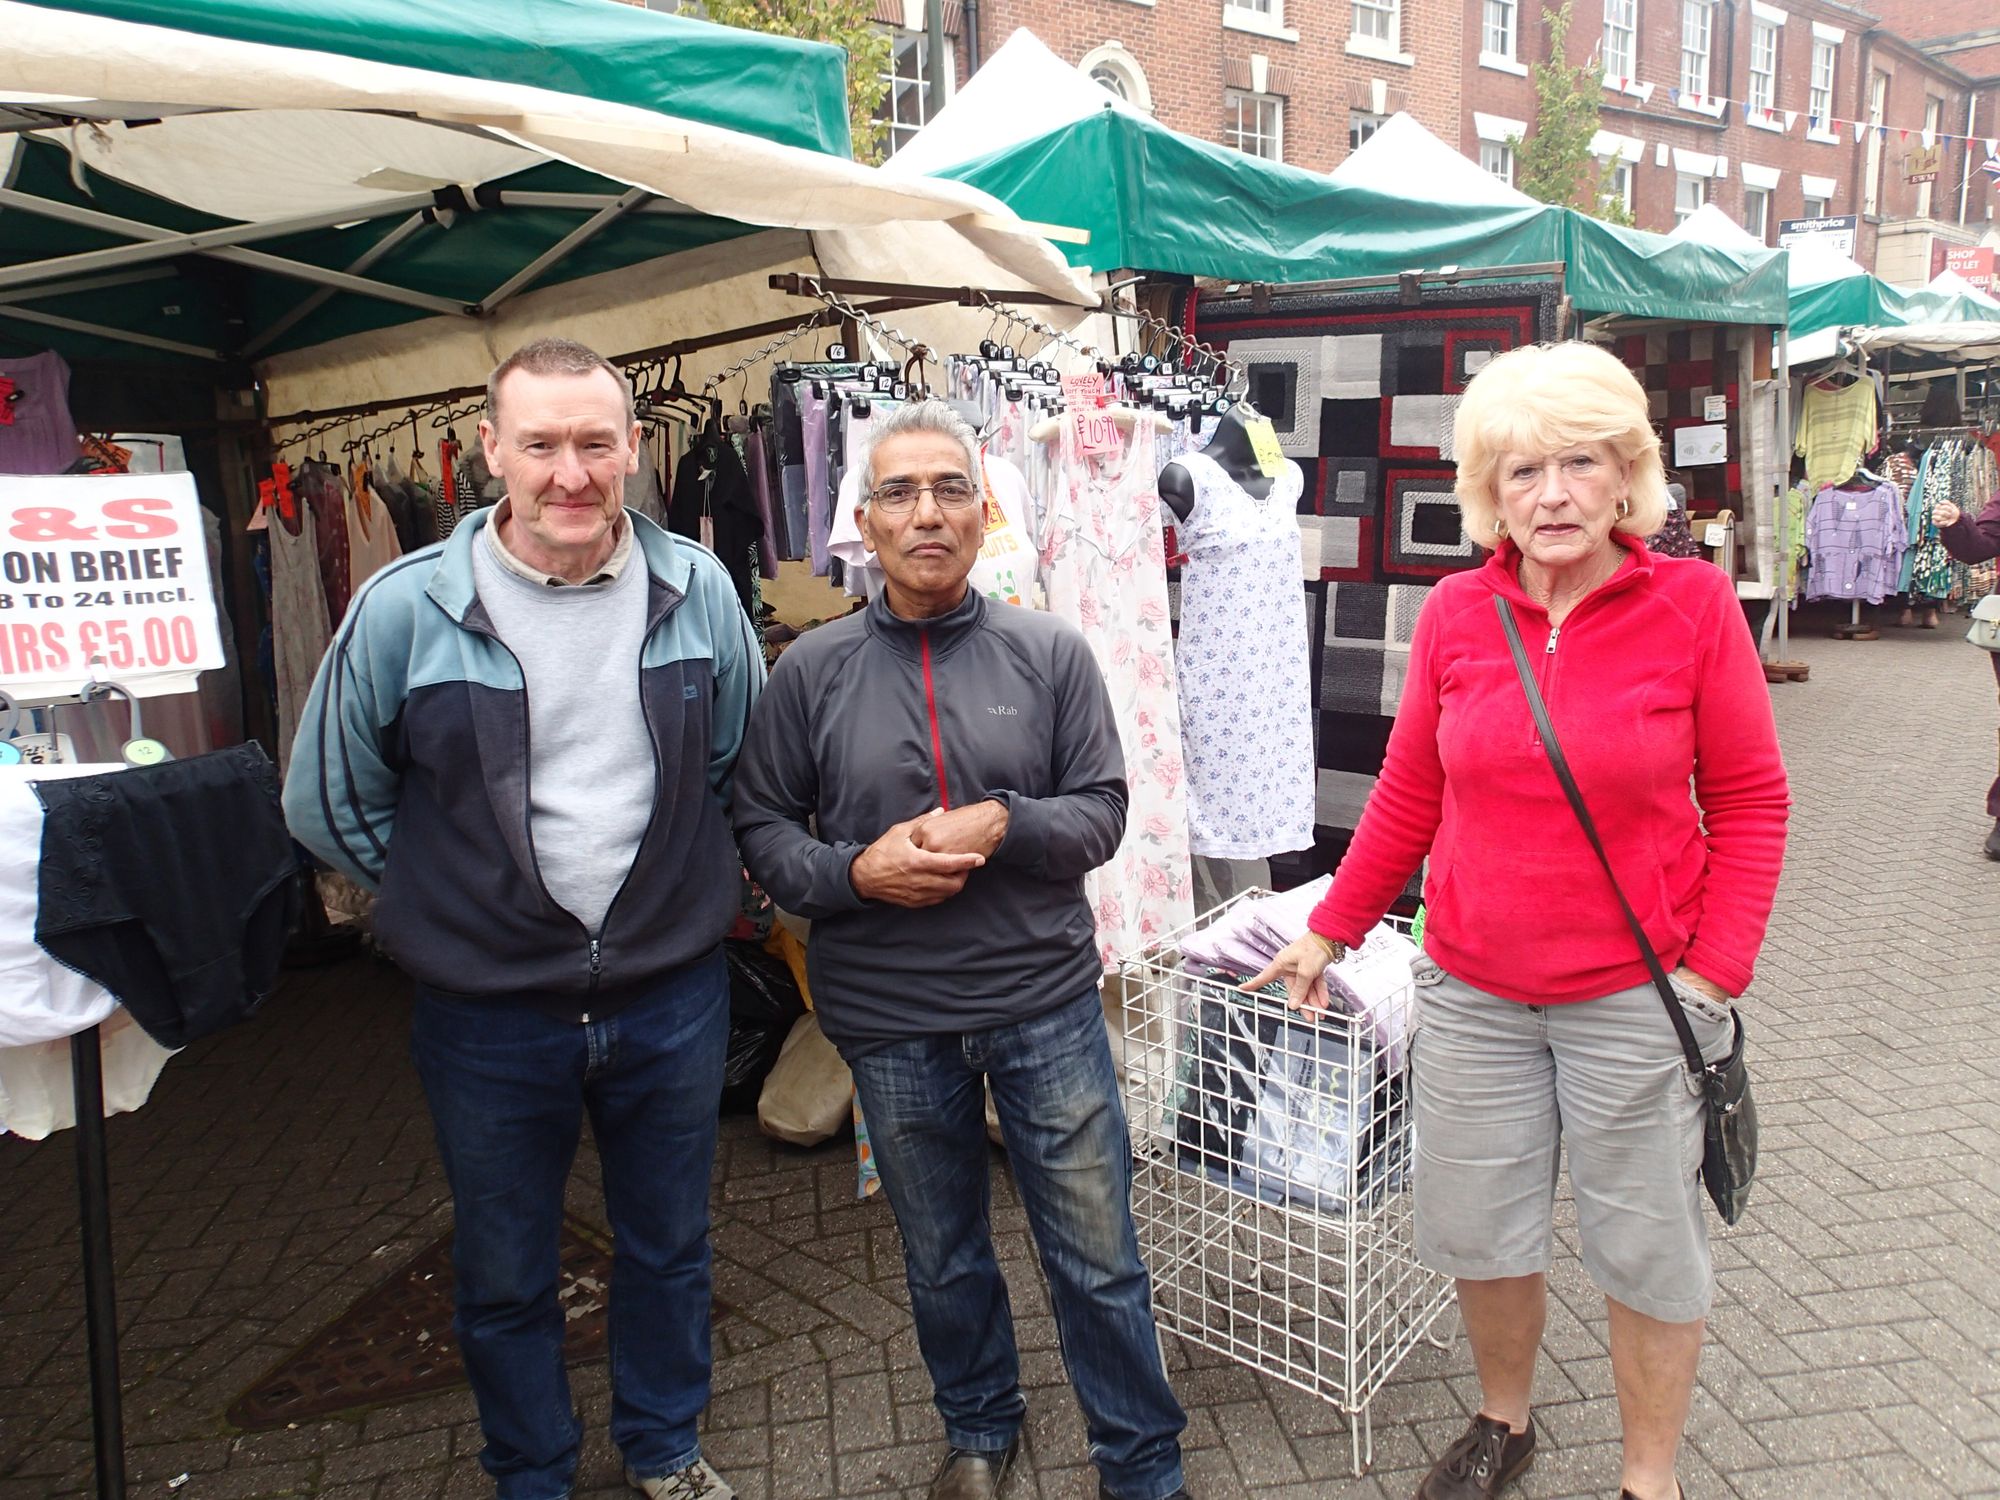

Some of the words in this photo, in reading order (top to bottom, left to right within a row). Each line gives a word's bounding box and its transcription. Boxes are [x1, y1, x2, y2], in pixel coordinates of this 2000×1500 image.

[1947, 250, 1976, 260] SHOP
[1947, 261, 1961, 270] TO
[1963, 260, 1979, 270] LET
[1070, 375, 1099, 387] LOVELY
[70, 547, 184, 582] BRIEF
[22, 593, 65, 609] To
[73, 591, 115, 607] 24
[123, 587, 196, 605] incl.
[78, 615, 199, 670] £5.00
[998, 705, 1018, 716] Rab
